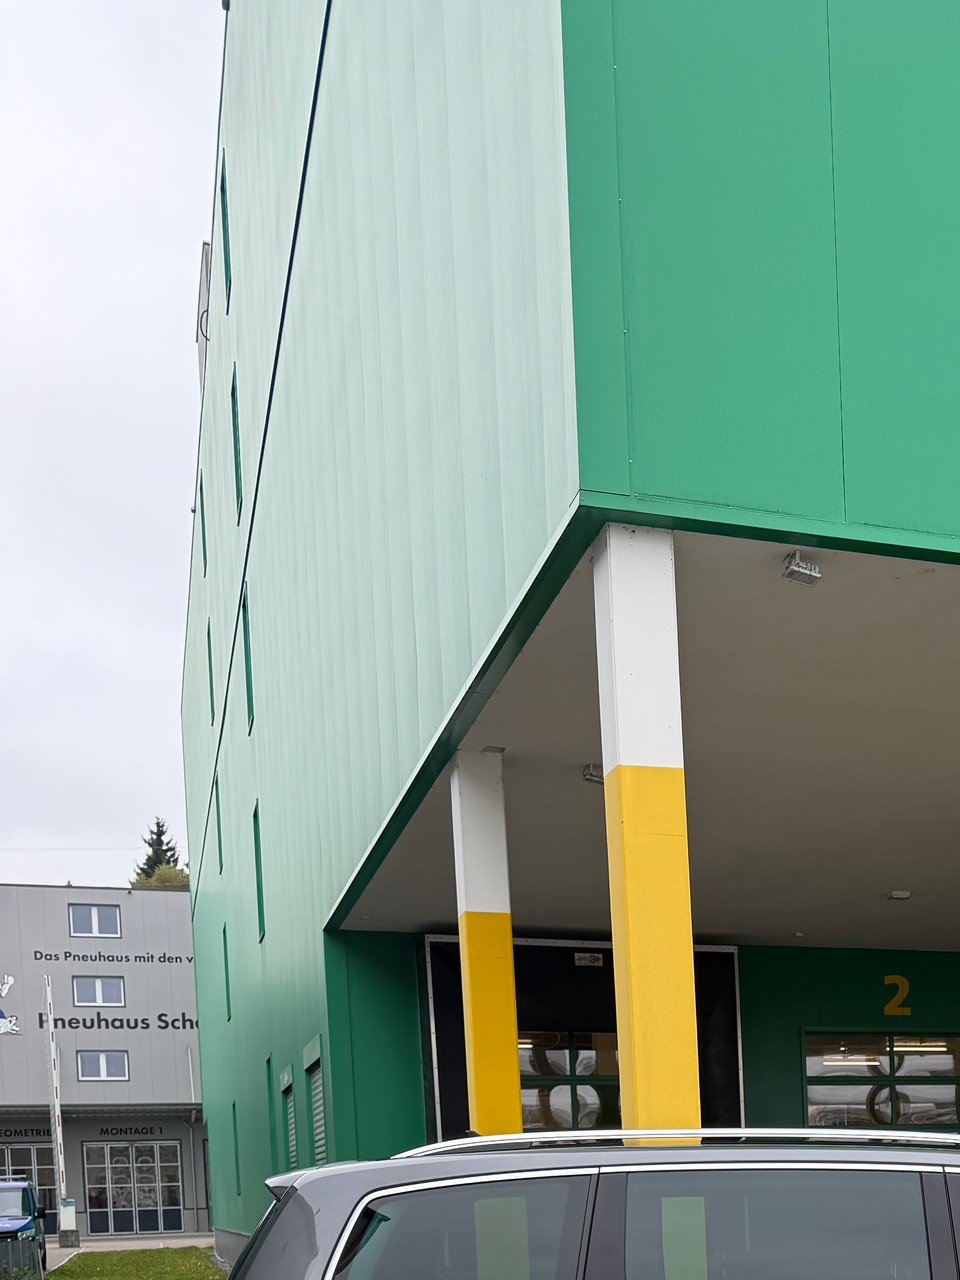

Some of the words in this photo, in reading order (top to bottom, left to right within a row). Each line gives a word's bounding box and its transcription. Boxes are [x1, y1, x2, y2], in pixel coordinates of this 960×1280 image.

[34, 951, 60, 962] Das
[64, 951, 130, 963] Pneuhaus
[134, 952, 155, 963] mit
[158, 952, 182, 963] den
[884, 975, 911, 1015] 2
[100, 1127, 154, 1136] MONTAGE
[158, 1127, 164, 1135] 1
